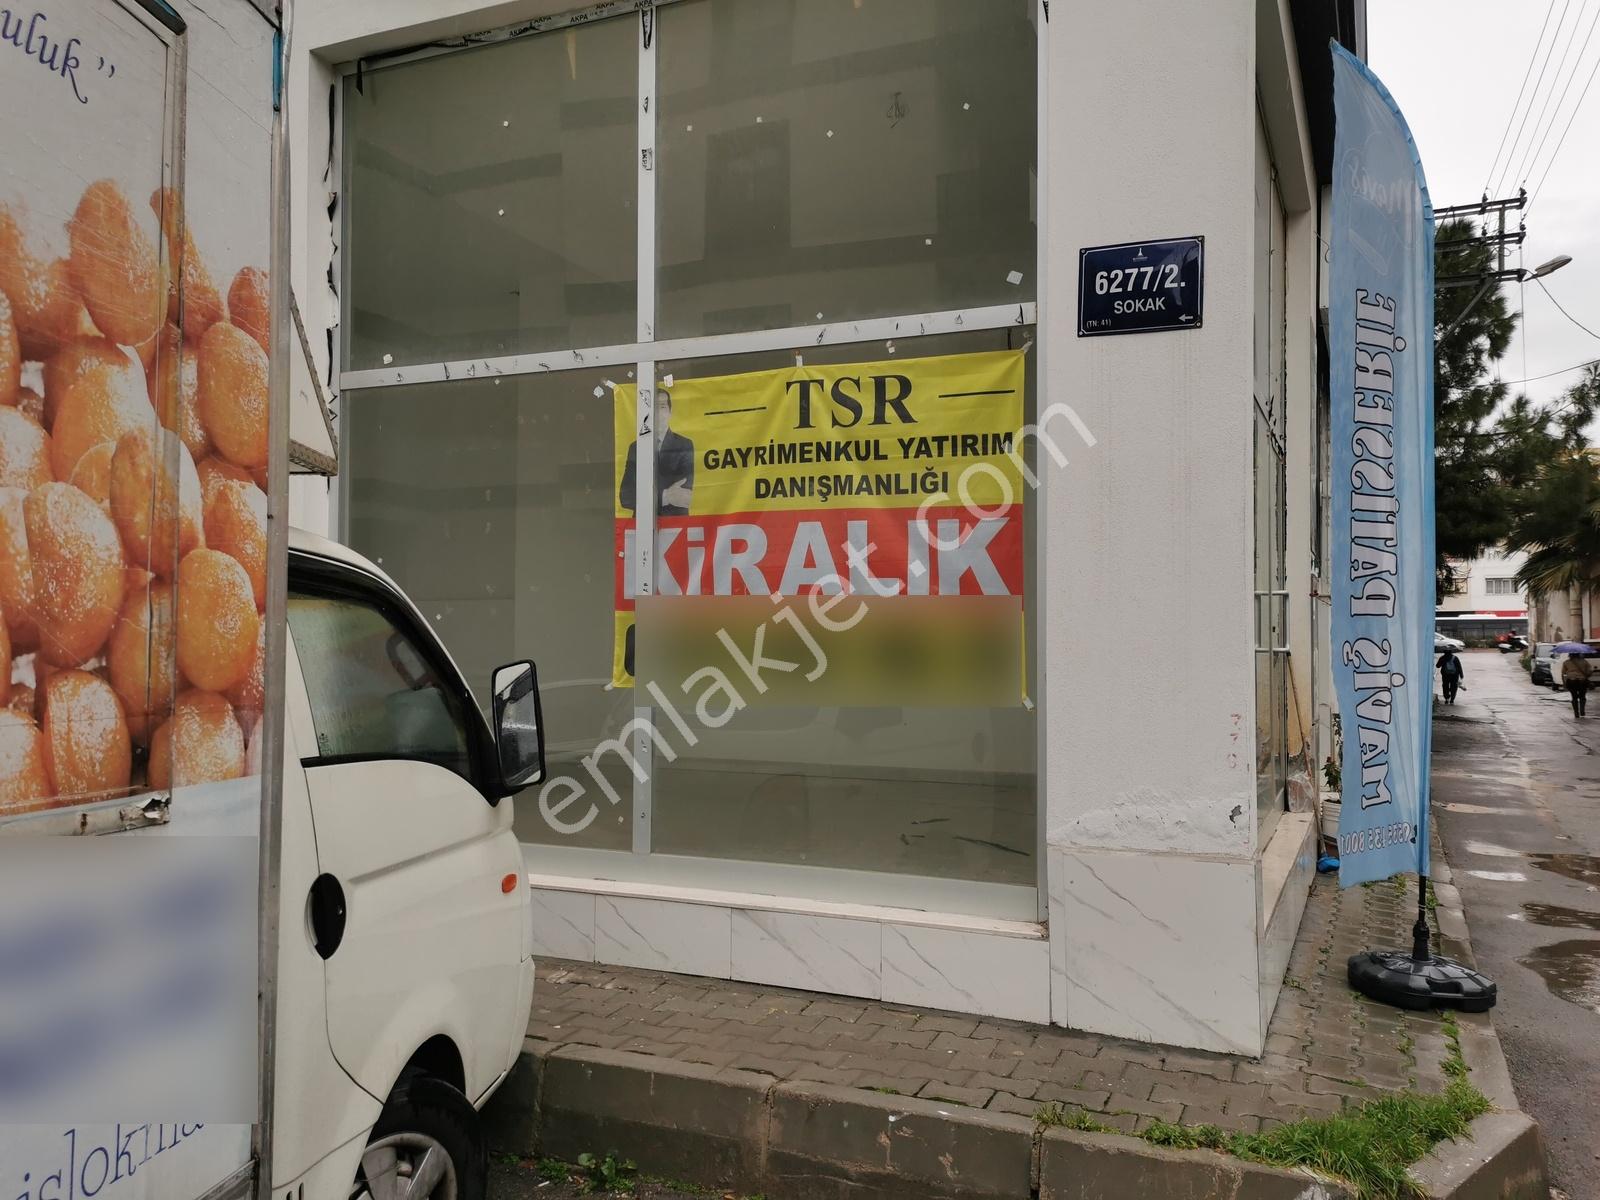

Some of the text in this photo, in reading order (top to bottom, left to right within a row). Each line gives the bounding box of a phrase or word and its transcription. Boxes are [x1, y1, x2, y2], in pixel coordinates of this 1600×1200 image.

[1095, 264, 1186, 295] 6277/2.
[1114, 297, 1166, 314] SOKAK
[1086, 319, 1112, 329] (TN: 41)
[786, 374, 917, 430] TSR
[703, 431, 1014, 470] GAYRİMENKUL YATIRIM
[754, 466, 949, 502] DANIŞMANLIĞI
